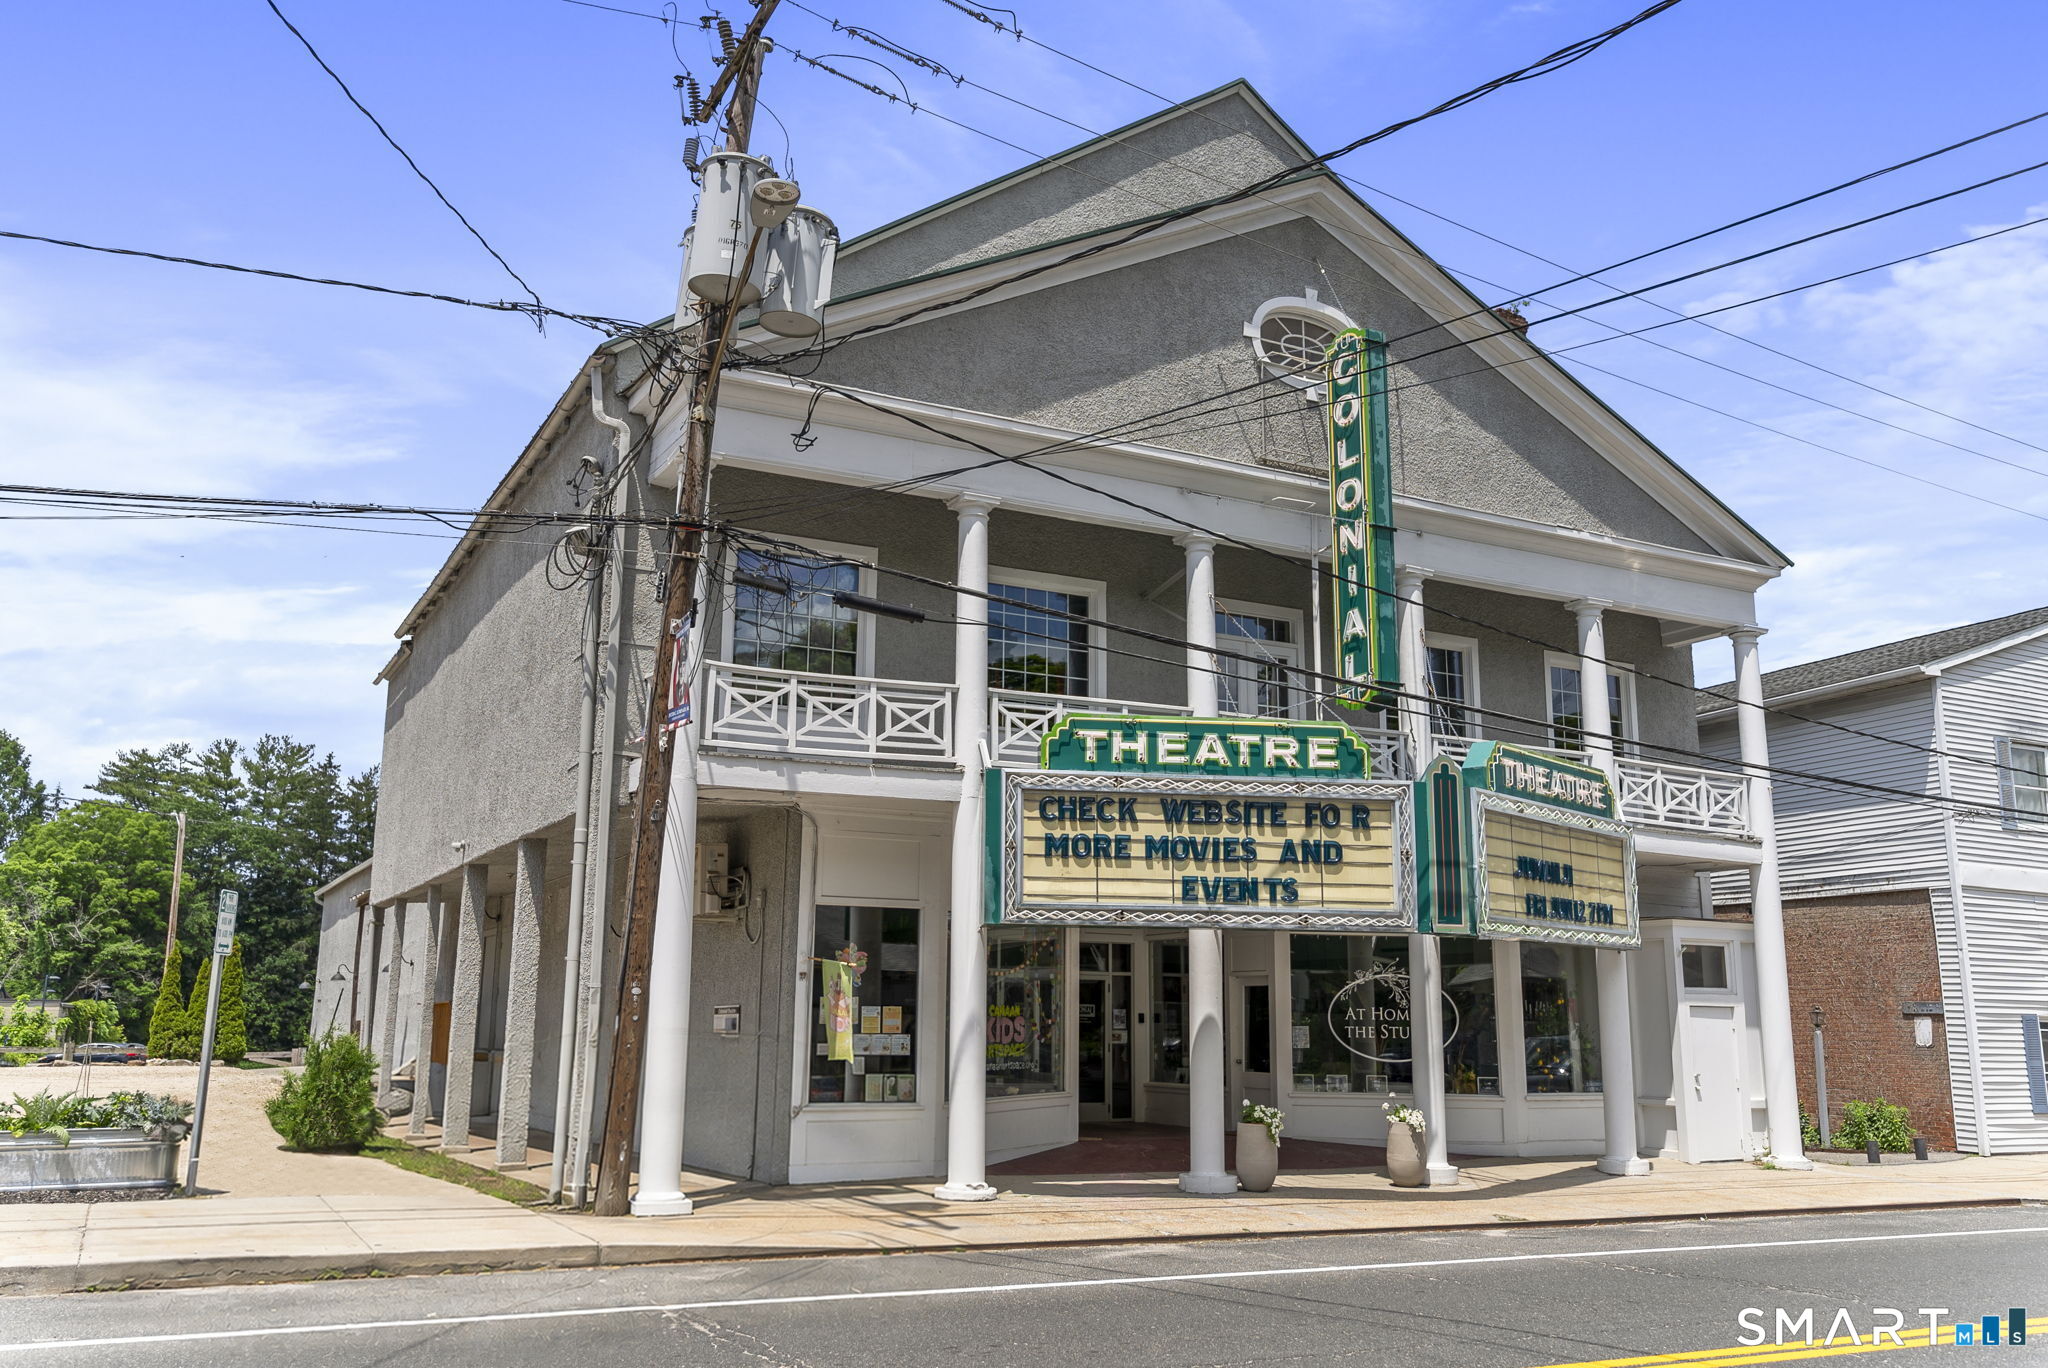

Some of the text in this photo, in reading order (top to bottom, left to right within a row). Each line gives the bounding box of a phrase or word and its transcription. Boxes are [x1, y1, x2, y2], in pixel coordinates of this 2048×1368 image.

[730, 219, 742, 229] 75
[1332, 351, 1367, 687] COLONIAL
[1073, 728, 1344, 770] THEATRE
[1498, 756, 1607, 809] THEATRE
[1038, 796, 1137, 824] CHECK
[1160, 799, 1288, 826] WEBSITE
[1043, 832, 1344, 865] MORE MOVIES AND
[1181, 876, 1298, 903] EVENTS
[989, 1005, 1021, 1017] CANAAN
[1344, 1007, 1410, 1021] AT HOM
[1344, 1024, 1410, 1039] THE STU
